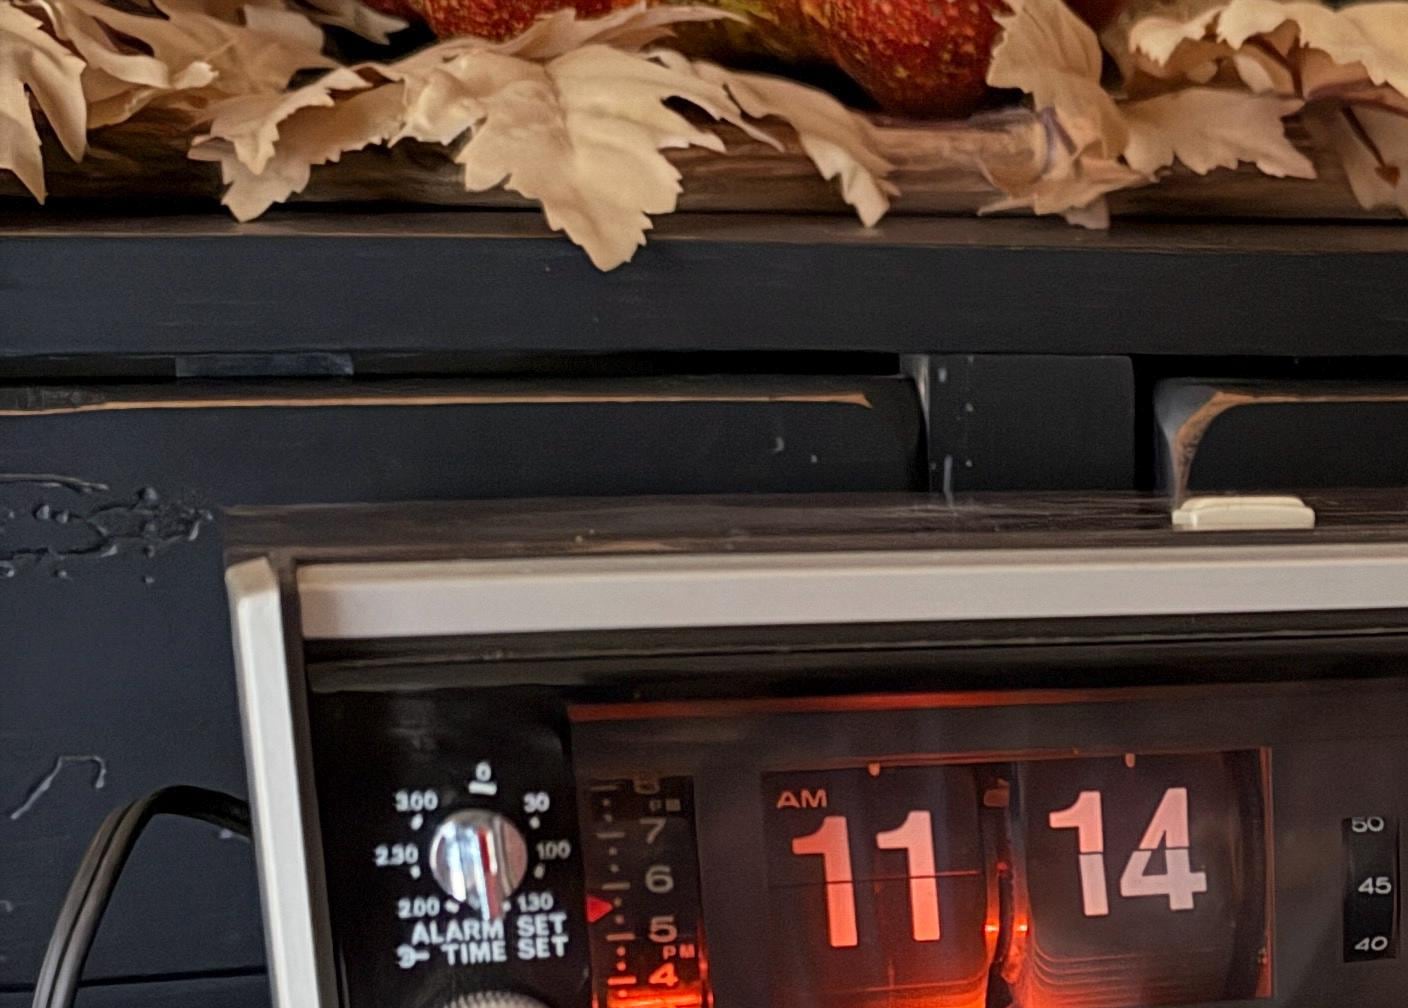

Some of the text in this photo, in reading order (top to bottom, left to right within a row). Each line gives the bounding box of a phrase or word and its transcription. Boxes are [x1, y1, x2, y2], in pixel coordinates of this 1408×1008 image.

[776, 788, 828, 809] AM
[640, 817, 667, 844] 7
[1352, 816, 1384, 833] 50
[1049, 786, 1207, 916] 14
[645, 865, 674, 893] 6
[791, 809, 941, 948] 11
[1358, 876, 1392, 894] 45
[412, 912, 567, 945] ALARM SET
[648, 915, 677, 943] 5
[441, 935, 568, 966] TIME SET
[1354, 936, 1388, 951] 40
[649, 962, 679, 987] 4
